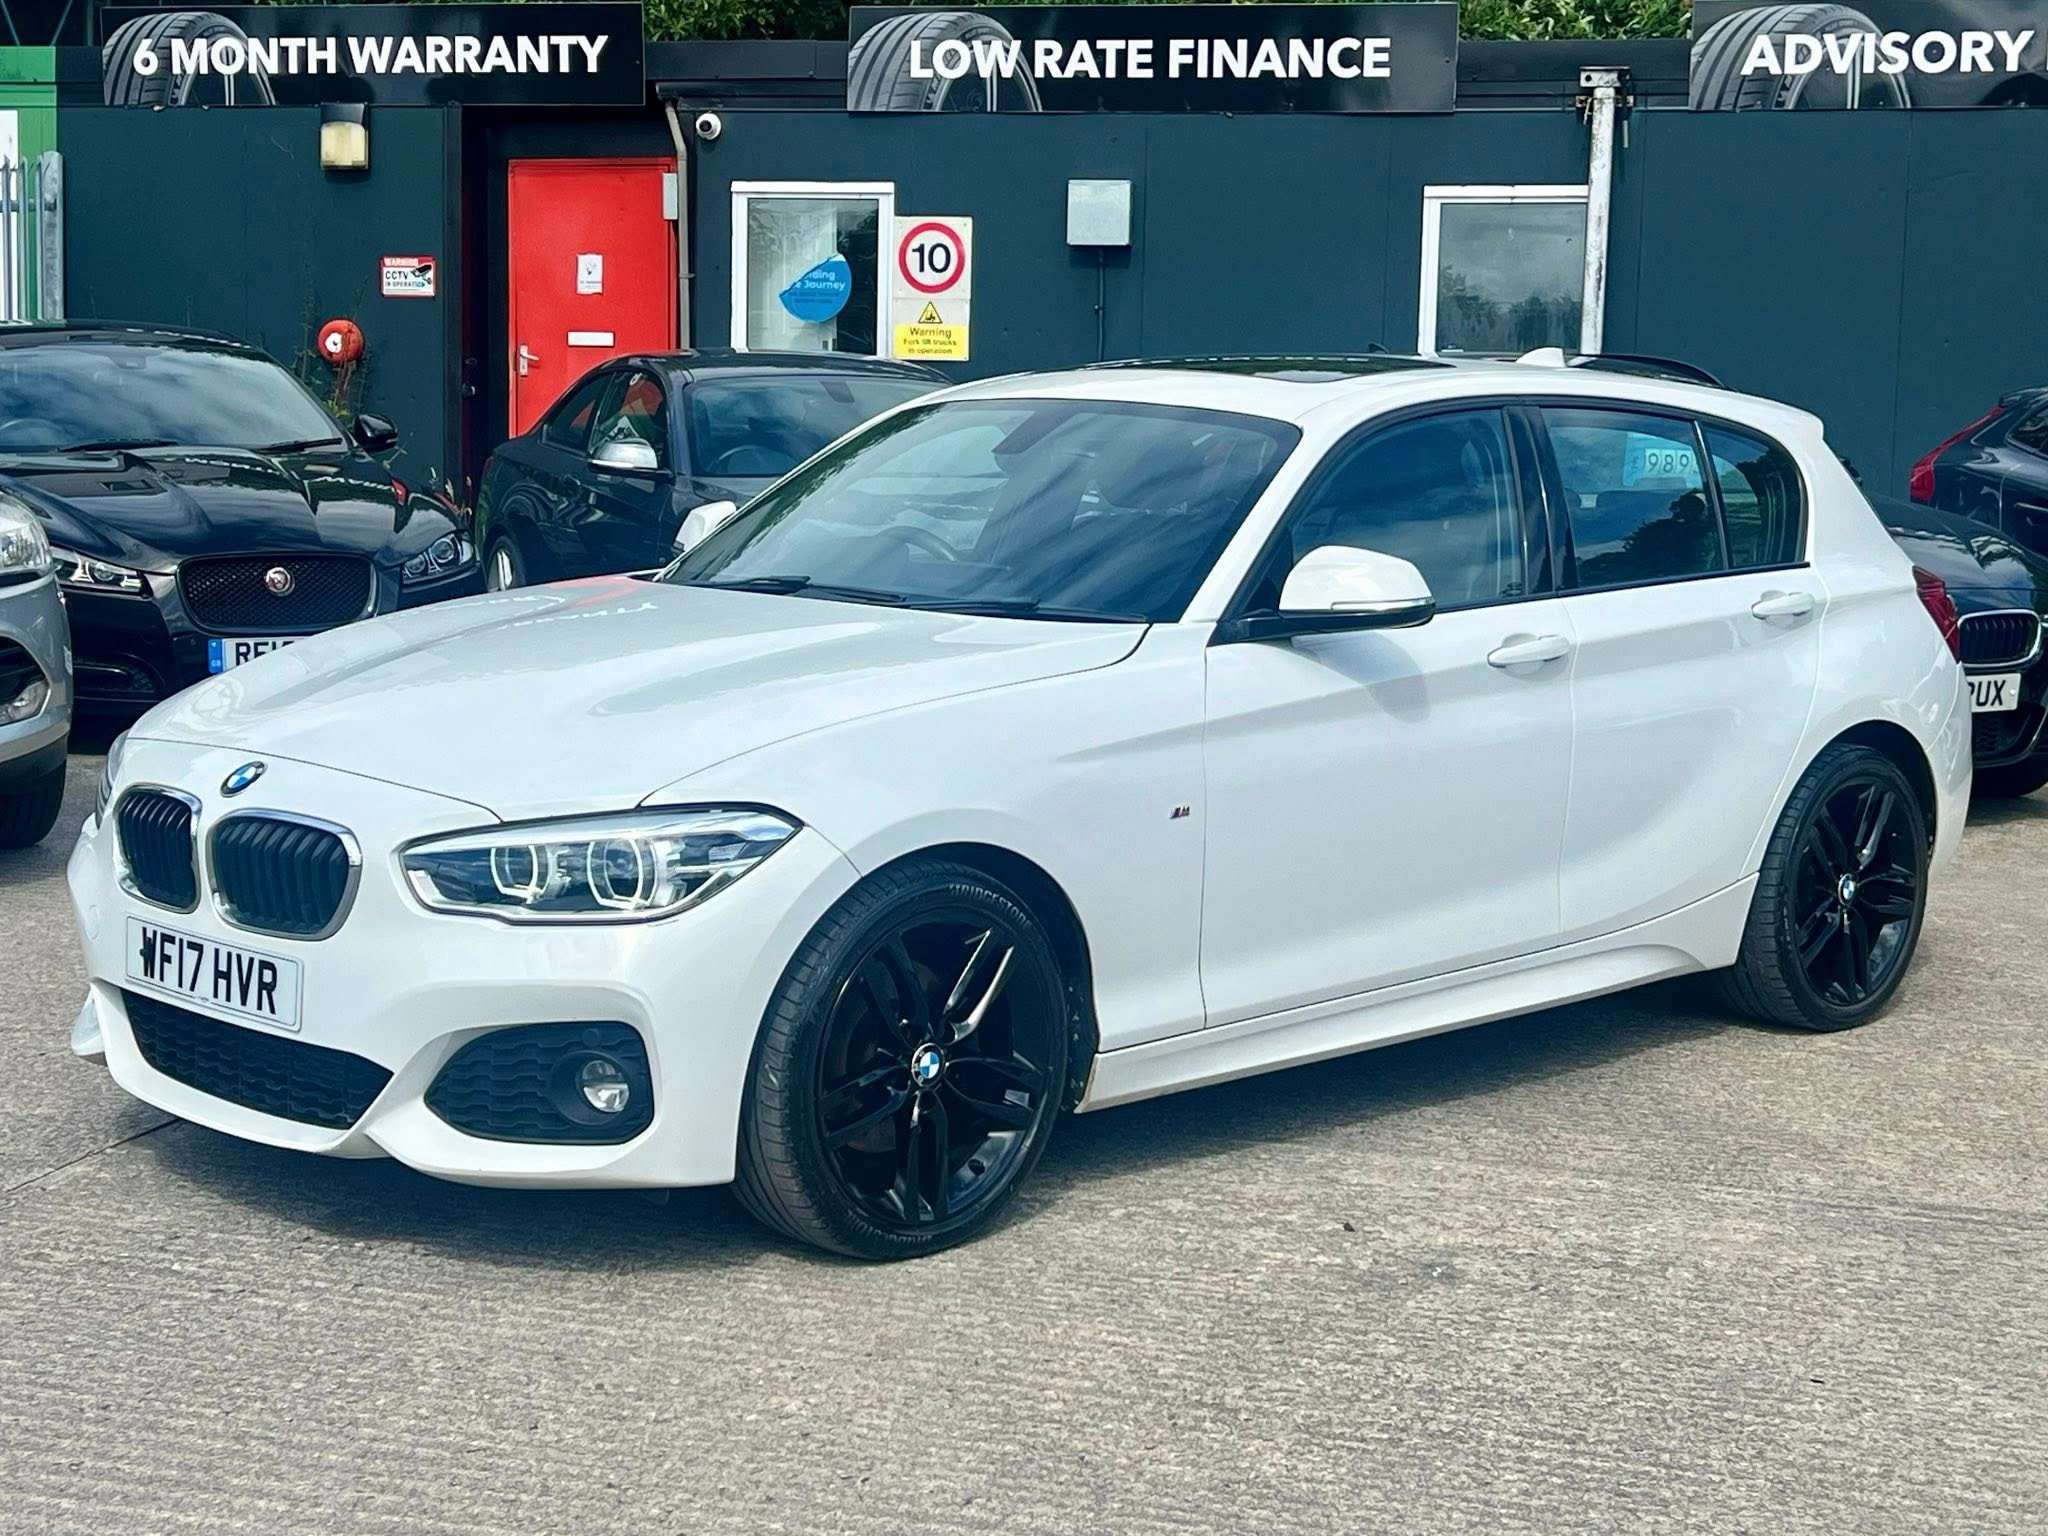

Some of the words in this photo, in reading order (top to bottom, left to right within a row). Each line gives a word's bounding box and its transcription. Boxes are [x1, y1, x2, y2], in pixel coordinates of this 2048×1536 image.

[133, 38, 158, 76] 6
[171, 36, 336, 76] MONTH
[347, 35, 609, 74] WARRANTY
[910, 39, 1022, 79] LOW
[1034, 38, 1153, 78] RATE
[1169, 37, 1391, 78] FINANCE
[1740, 30, 2036, 75] ADVISORY
[912, 242, 951, 274] 10
[385, 270, 408, 280] CCTV
[803, 280, 846, 291] Journey
[909, 327, 952, 340] Warning
[1648, 452, 1689, 474] 989
[139, 926, 204, 992] WF17
[213, 947, 278, 1015] HVR
